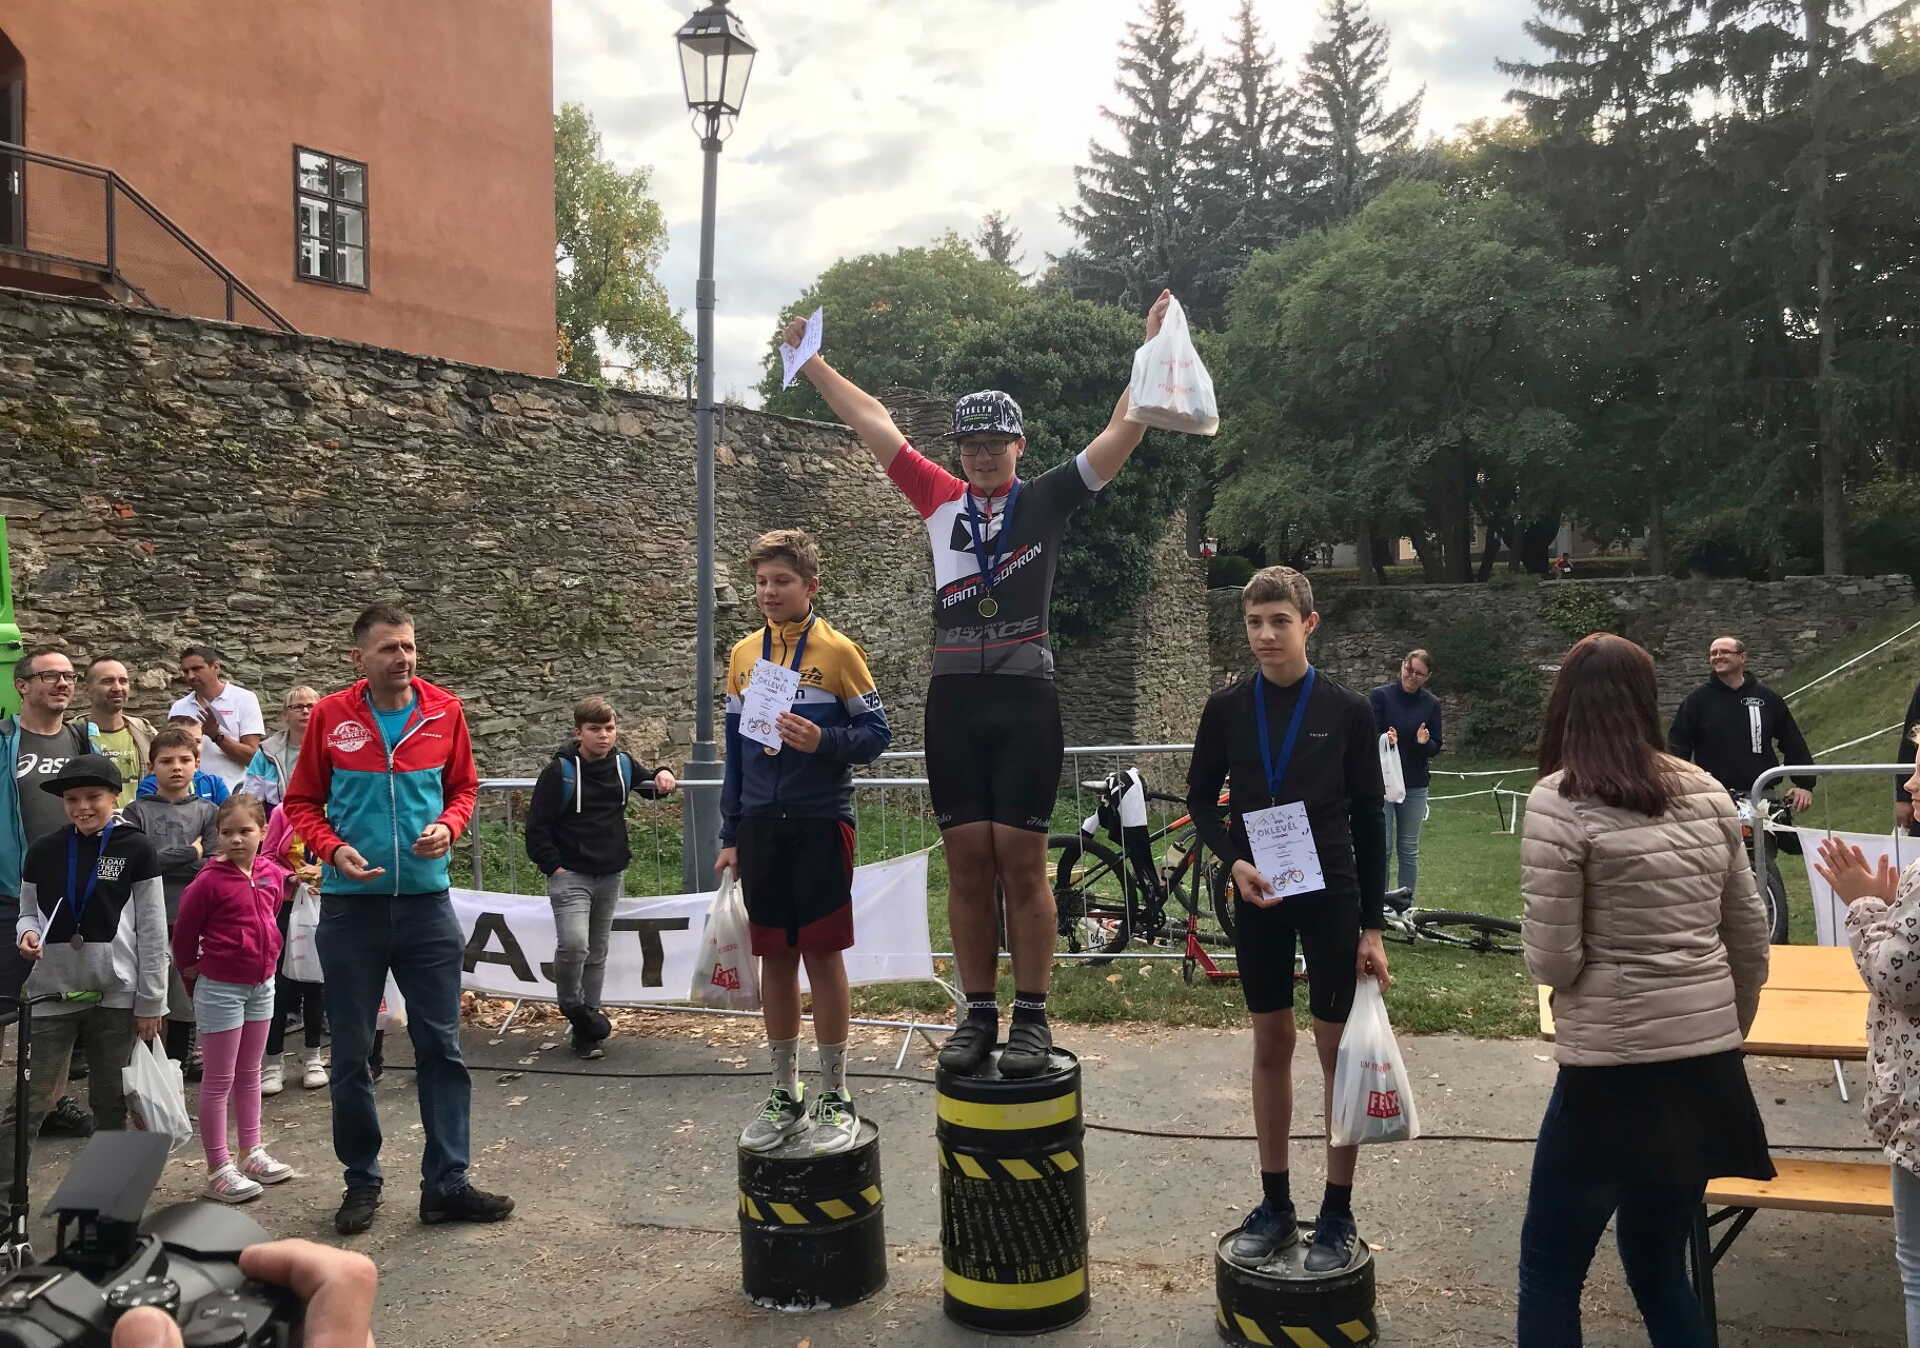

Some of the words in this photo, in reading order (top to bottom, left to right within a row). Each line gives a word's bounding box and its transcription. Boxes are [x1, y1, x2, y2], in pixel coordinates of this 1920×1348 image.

[942, 585, 977, 609] TEAM
[993, 541, 1042, 587] SOPRON
[463, 911, 690, 988] AT
